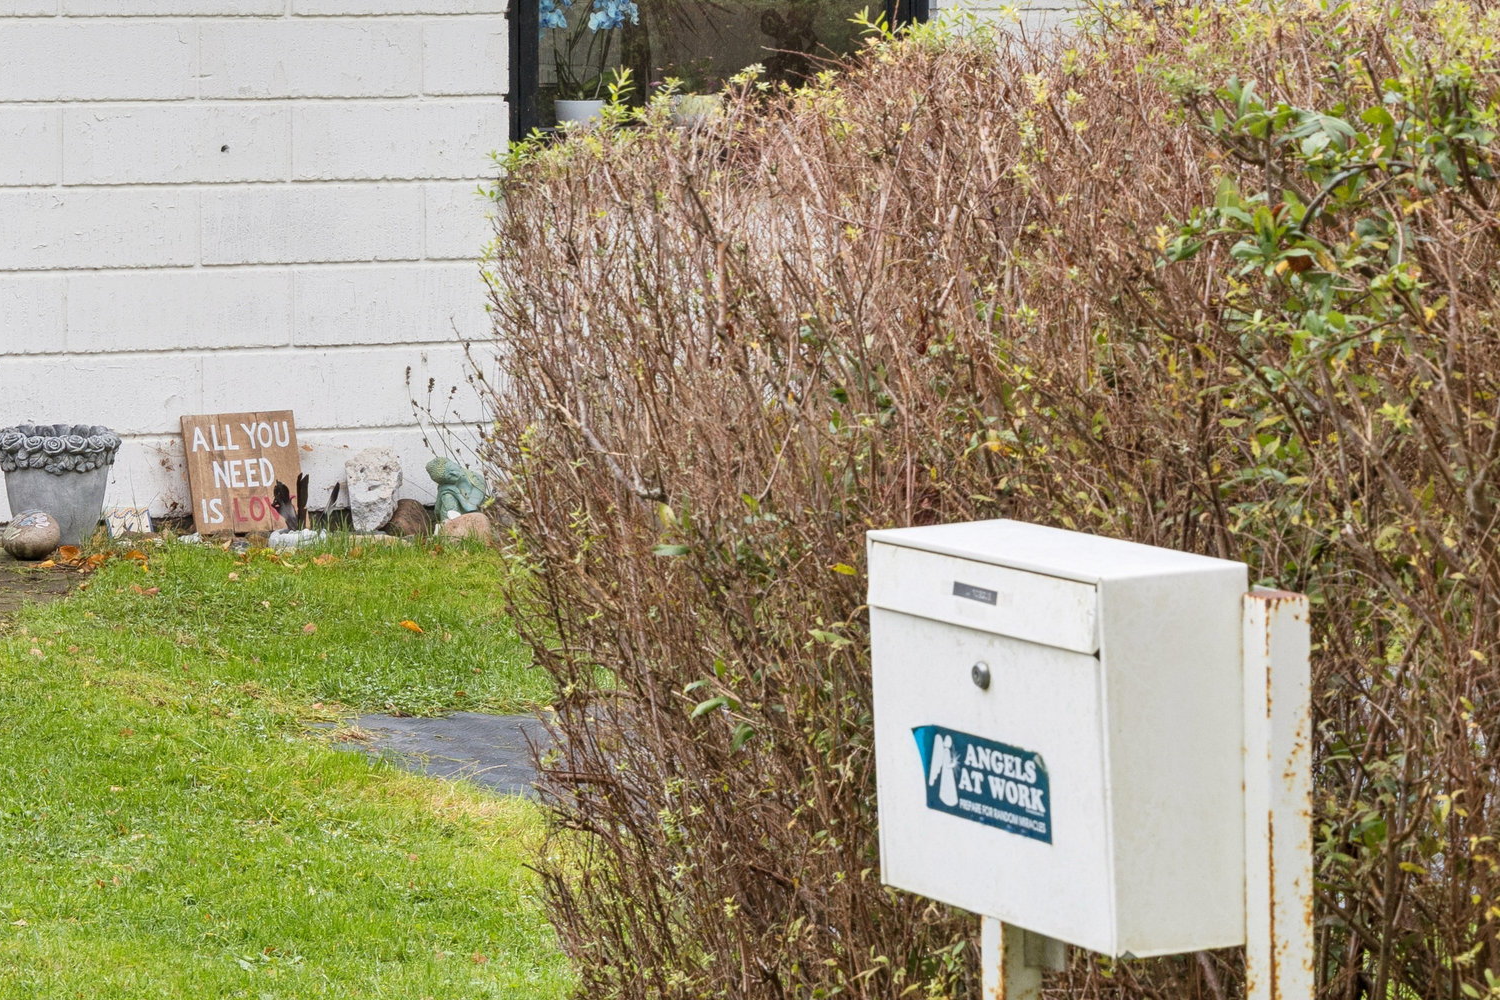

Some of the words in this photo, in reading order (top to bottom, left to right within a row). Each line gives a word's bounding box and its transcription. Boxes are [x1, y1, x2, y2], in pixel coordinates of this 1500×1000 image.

[192, 424, 240, 452] ALL
[240, 421, 290, 449] YOU
[212, 457, 275, 488] NEED
[201, 498, 225, 524] IS
[964, 743, 1037, 784] ANGELS
[958, 767, 984, 795] AT
[987, 775, 1046, 813] WORK
